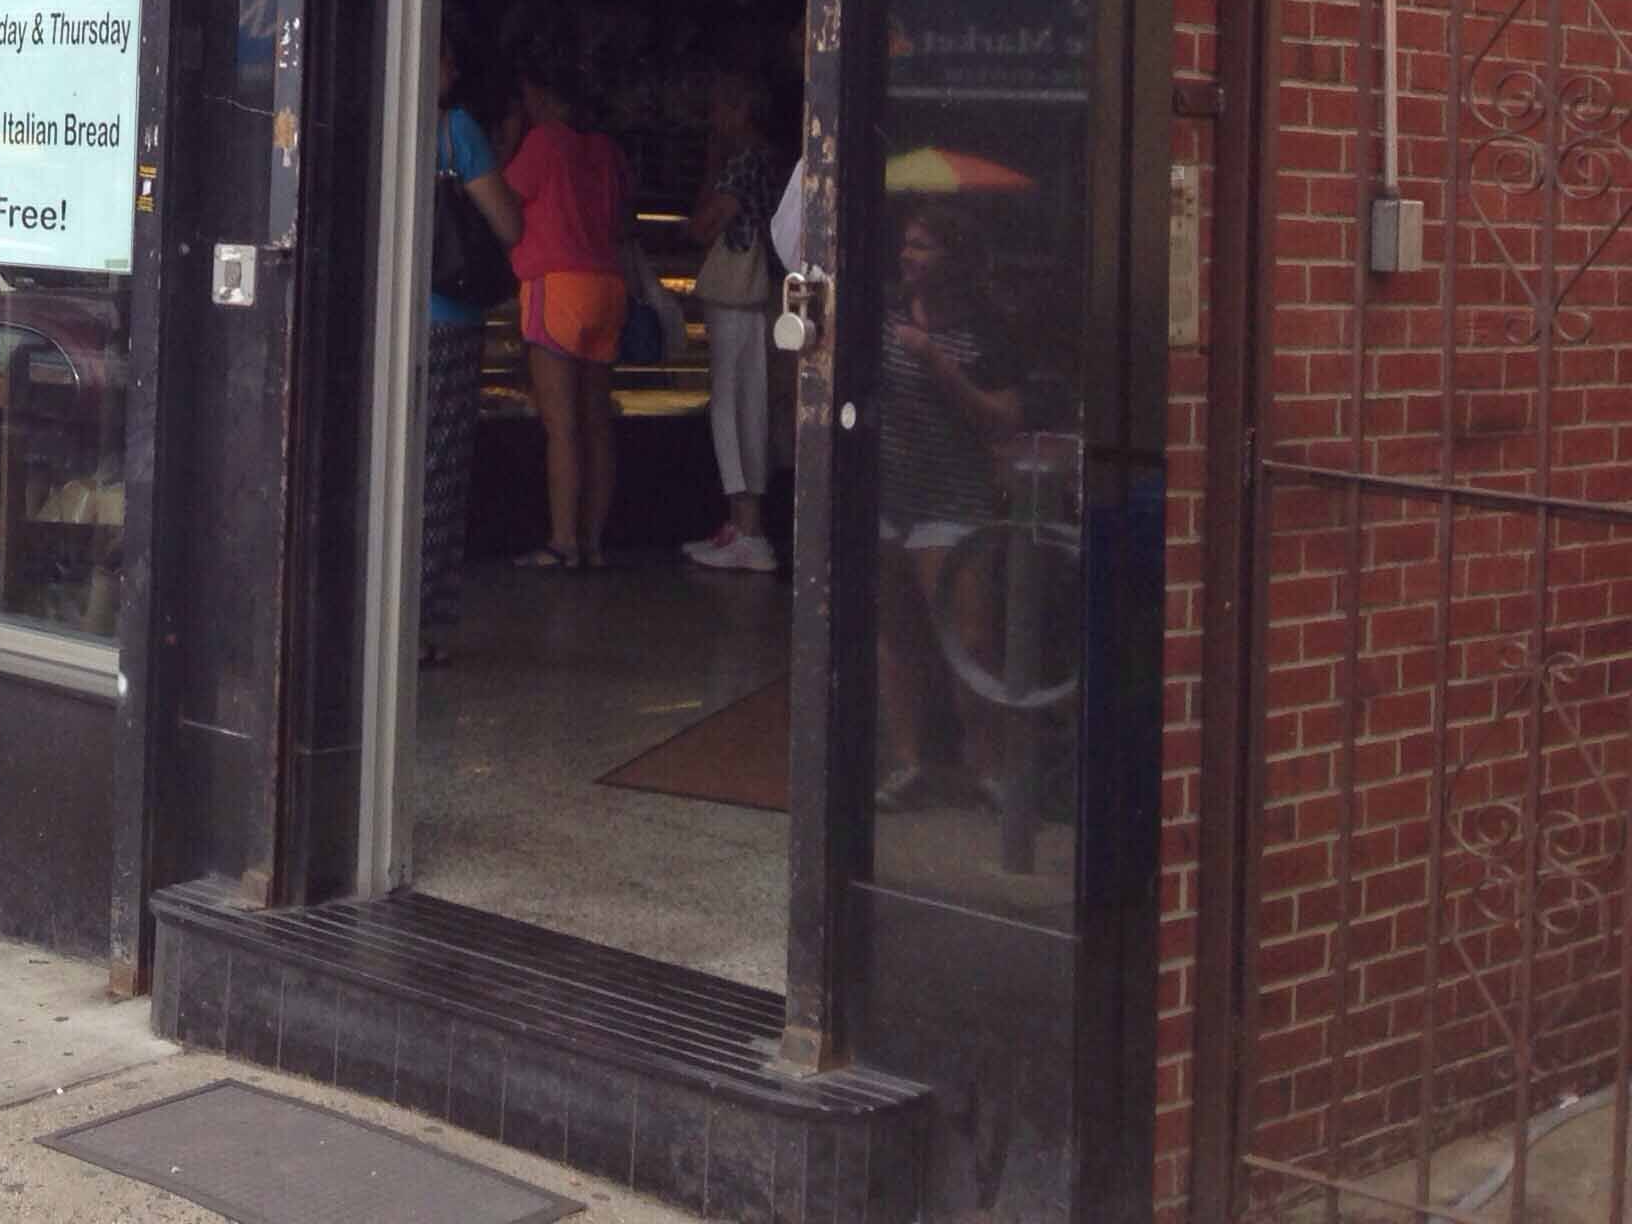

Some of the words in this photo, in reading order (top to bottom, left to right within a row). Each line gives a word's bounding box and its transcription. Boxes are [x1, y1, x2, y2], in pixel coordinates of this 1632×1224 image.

[31, 15, 44, 46] &
[50, 13, 130, 54] Thursday
[2, 113, 58, 145] Italian
[64, 114, 120, 147] Bread
